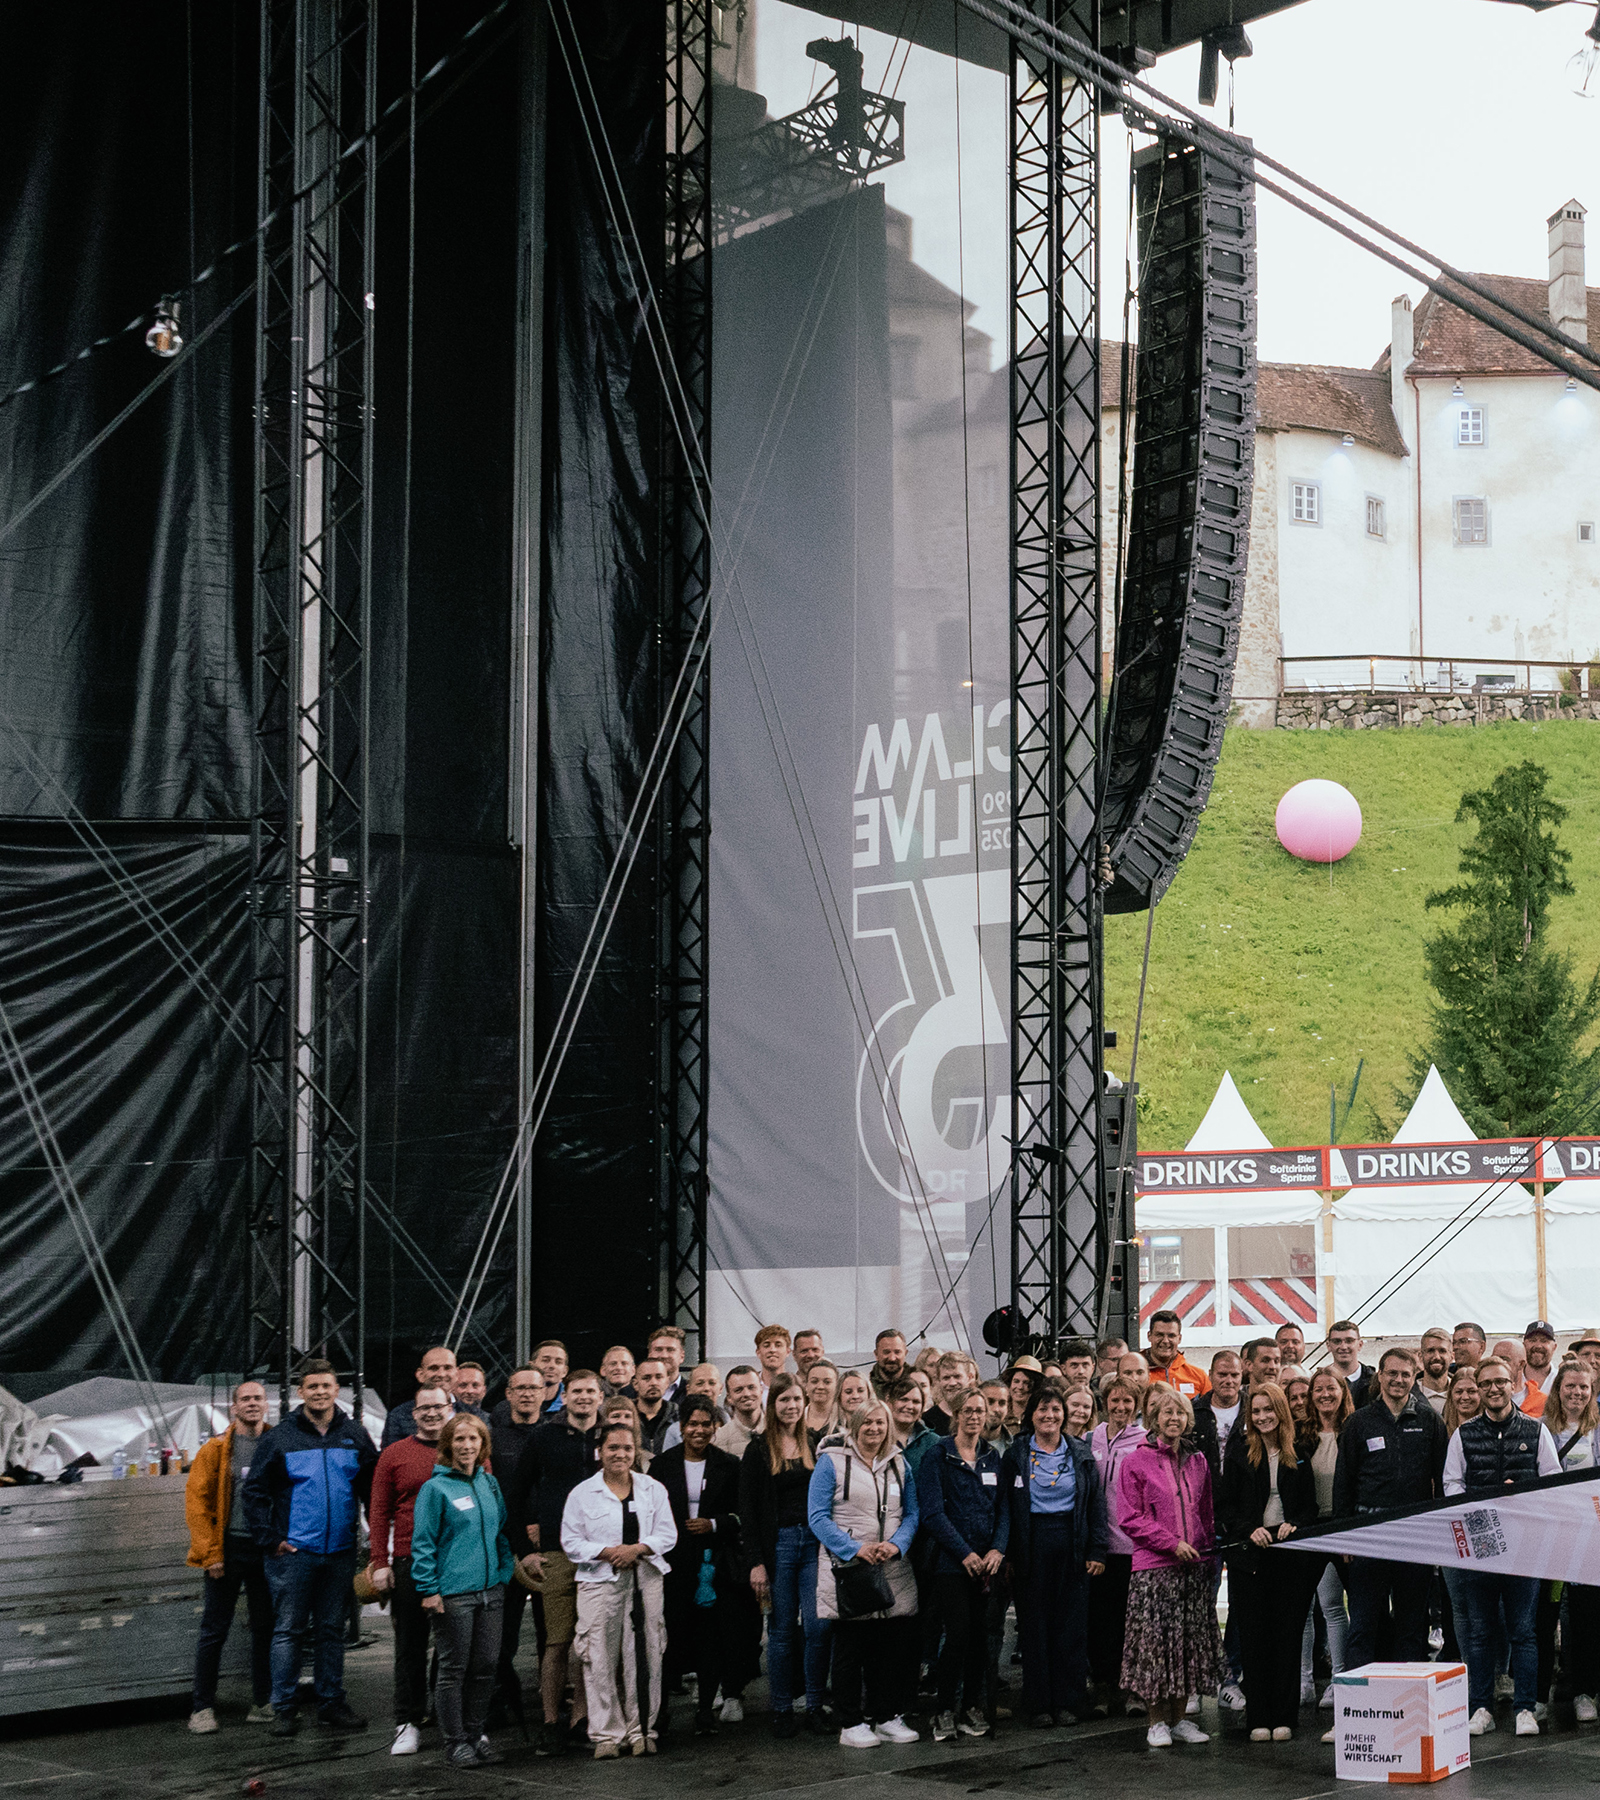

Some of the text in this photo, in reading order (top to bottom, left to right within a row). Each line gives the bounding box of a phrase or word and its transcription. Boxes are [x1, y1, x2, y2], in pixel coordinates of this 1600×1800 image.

[1509, 1146, 1529, 1155] Bier
[1297, 1154, 1317, 1164] Bier
[1357, 1151, 1472, 1179] DRINKS
[1142, 1159, 1258, 1186] DRINKS
[1269, 1163, 1317, 1175] Softdrinks
[1280, 1173, 1317, 1185] Spritzer
[1452, 1520, 1467, 1549] WKO
[1489, 1508, 1508, 1553] FIND US ON
[1343, 1707, 1405, 1719] #mehrmut
[1344, 1733, 1376, 1744] #MEHR
[1344, 1743, 1374, 1753] JUNGE
[1344, 1752, 1403, 1763] WIRTSCHAFT
